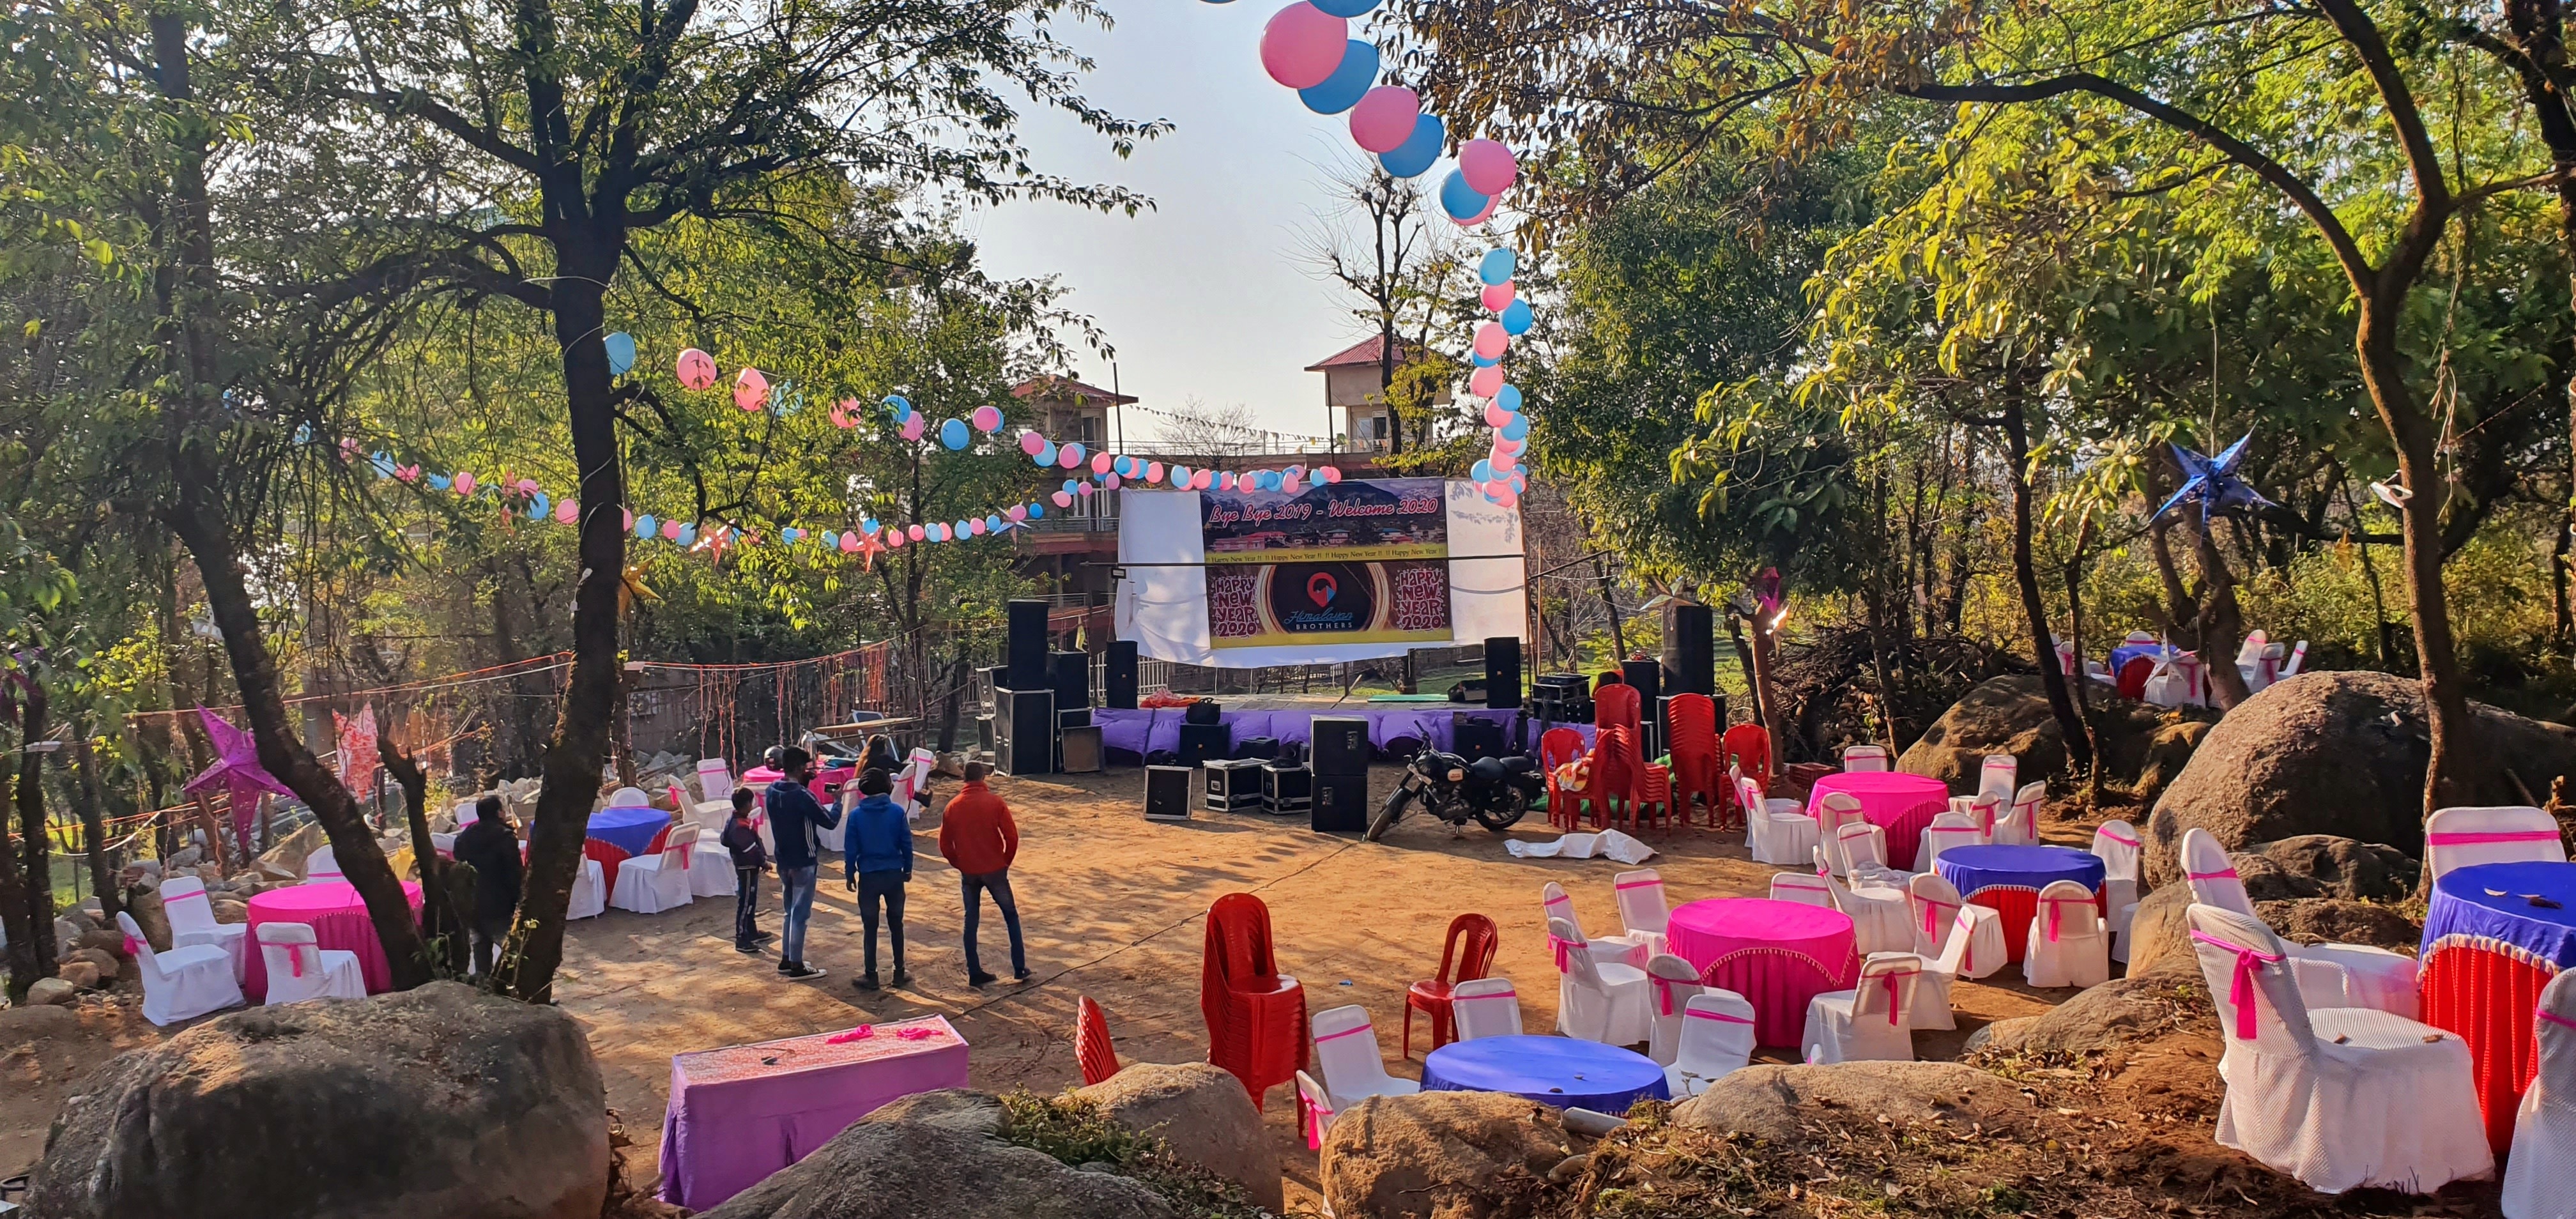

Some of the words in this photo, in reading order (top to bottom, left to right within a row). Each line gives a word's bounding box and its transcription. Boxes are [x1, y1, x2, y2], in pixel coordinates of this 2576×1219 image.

[1209, 504, 1239, 528] Bye
[1241, 503, 1272, 527] Bye
[1274, 503, 1312, 521] 2019
[1328, 498, 1395, 518] Welcome
[1397, 498, 1438, 515] 2020
[1284, 606, 1353, 624] Himalayan
[1402, 615, 1442, 631] 2020
[1218, 622, 1257, 637] 2020
